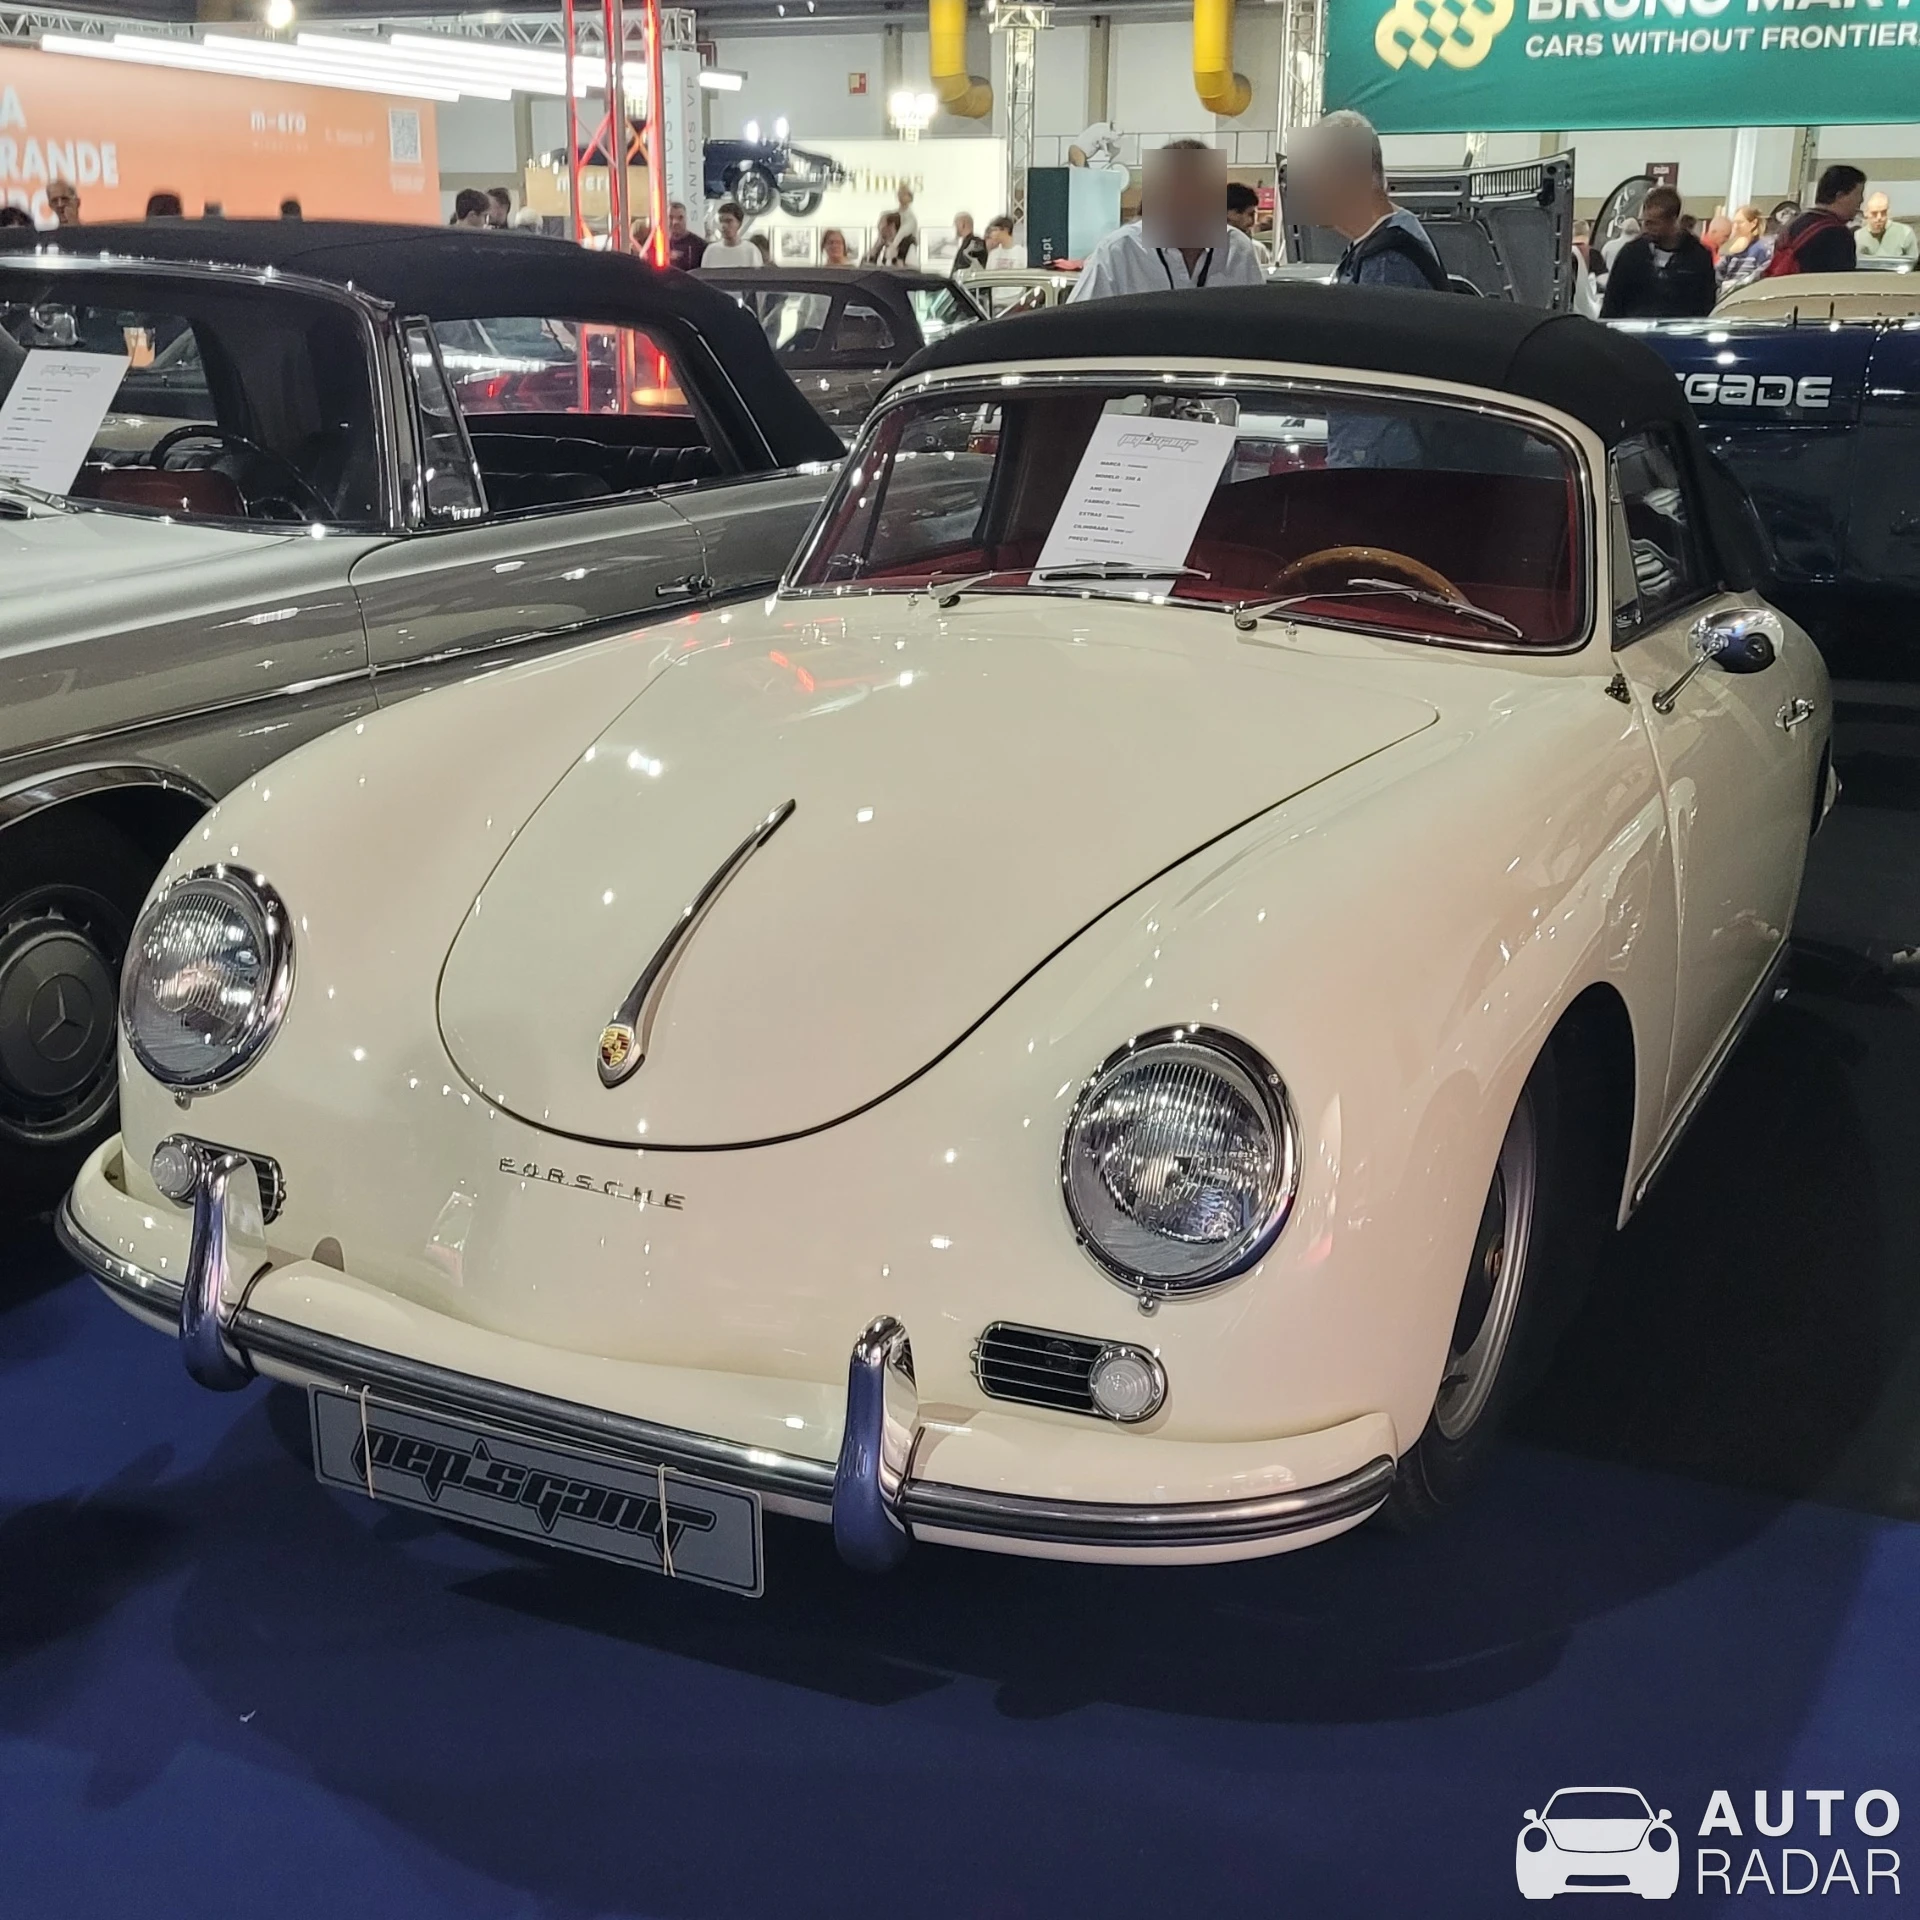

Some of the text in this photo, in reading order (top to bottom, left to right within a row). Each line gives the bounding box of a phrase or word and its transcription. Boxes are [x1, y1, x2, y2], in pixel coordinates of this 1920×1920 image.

[1525, 21, 1920, 59] CARS WITHOUT FRONTIER
[686, 76, 699, 222] SANTOS VP
[499, 1157, 686, 1210] PORSCHE
